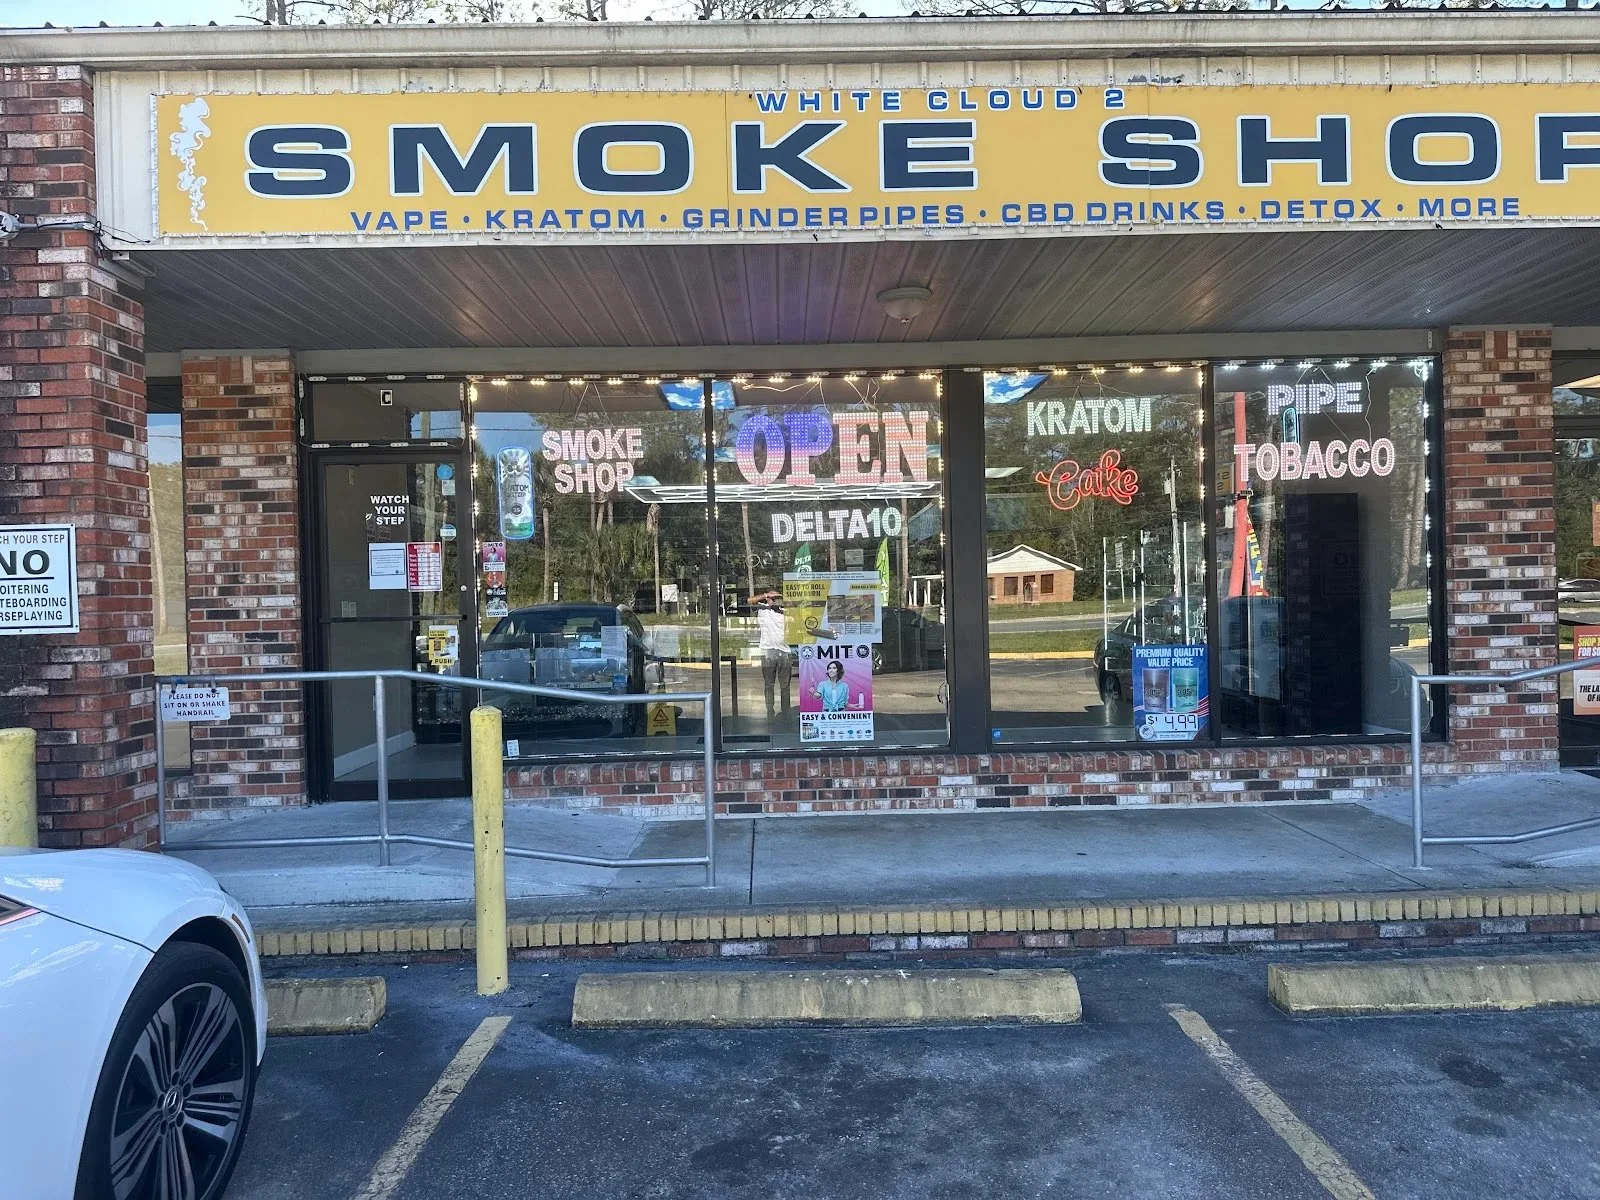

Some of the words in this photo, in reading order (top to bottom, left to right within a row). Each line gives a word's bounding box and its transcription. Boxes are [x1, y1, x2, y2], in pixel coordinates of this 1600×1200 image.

[755, 90, 901, 113] WHITE
[927, 88, 1077, 111] CLOUD
[1104, 87, 1125, 110] 2
[244, 118, 977, 199] SMOKE
[350, 211, 448, 231] VAPE
[486, 208, 645, 229] KRATOM
[683, 206, 848, 229] GRINDER
[860, 204, 964, 226] PIPES
[1001, 203, 1074, 223] CBD
[1086, 201, 1225, 221] DRINKS
[1260, 199, 1382, 219] DETOX
[1418, 197, 1520, 217] MORE
[381, 391, 392, 405] C
[1267, 381, 1363, 415] PIPE
[1027, 397, 1152, 436] KRATOM
[541, 427, 644, 461] SMOKE
[735, 410, 929, 487] OPEN
[1234, 437, 1396, 482] TOBACCO
[554, 461, 635, 494] SHOP
[1036, 448, 1139, 511] Cake
[370, 495, 410, 504] WATCH
[375, 506, 405, 514] YOUR
[376, 516, 405, 525] STEP
[13, 535, 38, 544] YOUR
[41, 534, 65, 544] STEP
[0, 549, 50, 576] NO
[1577, 637, 1597, 647] SHOP
[1136, 648, 1172, 658] PREMIUM
[1173, 647, 1204, 657] QUALITY
[1578, 647, 1592, 657] FOR
[1147, 658, 1171, 667] VALUE
[1171, 657, 1194, 667] PRICE
[1579, 685, 1591, 693] THE
[1587, 693, 1596, 702] OF
[176, 709, 215, 717] HANDRAIL
[827, 712, 872, 720] CONVENIENT
